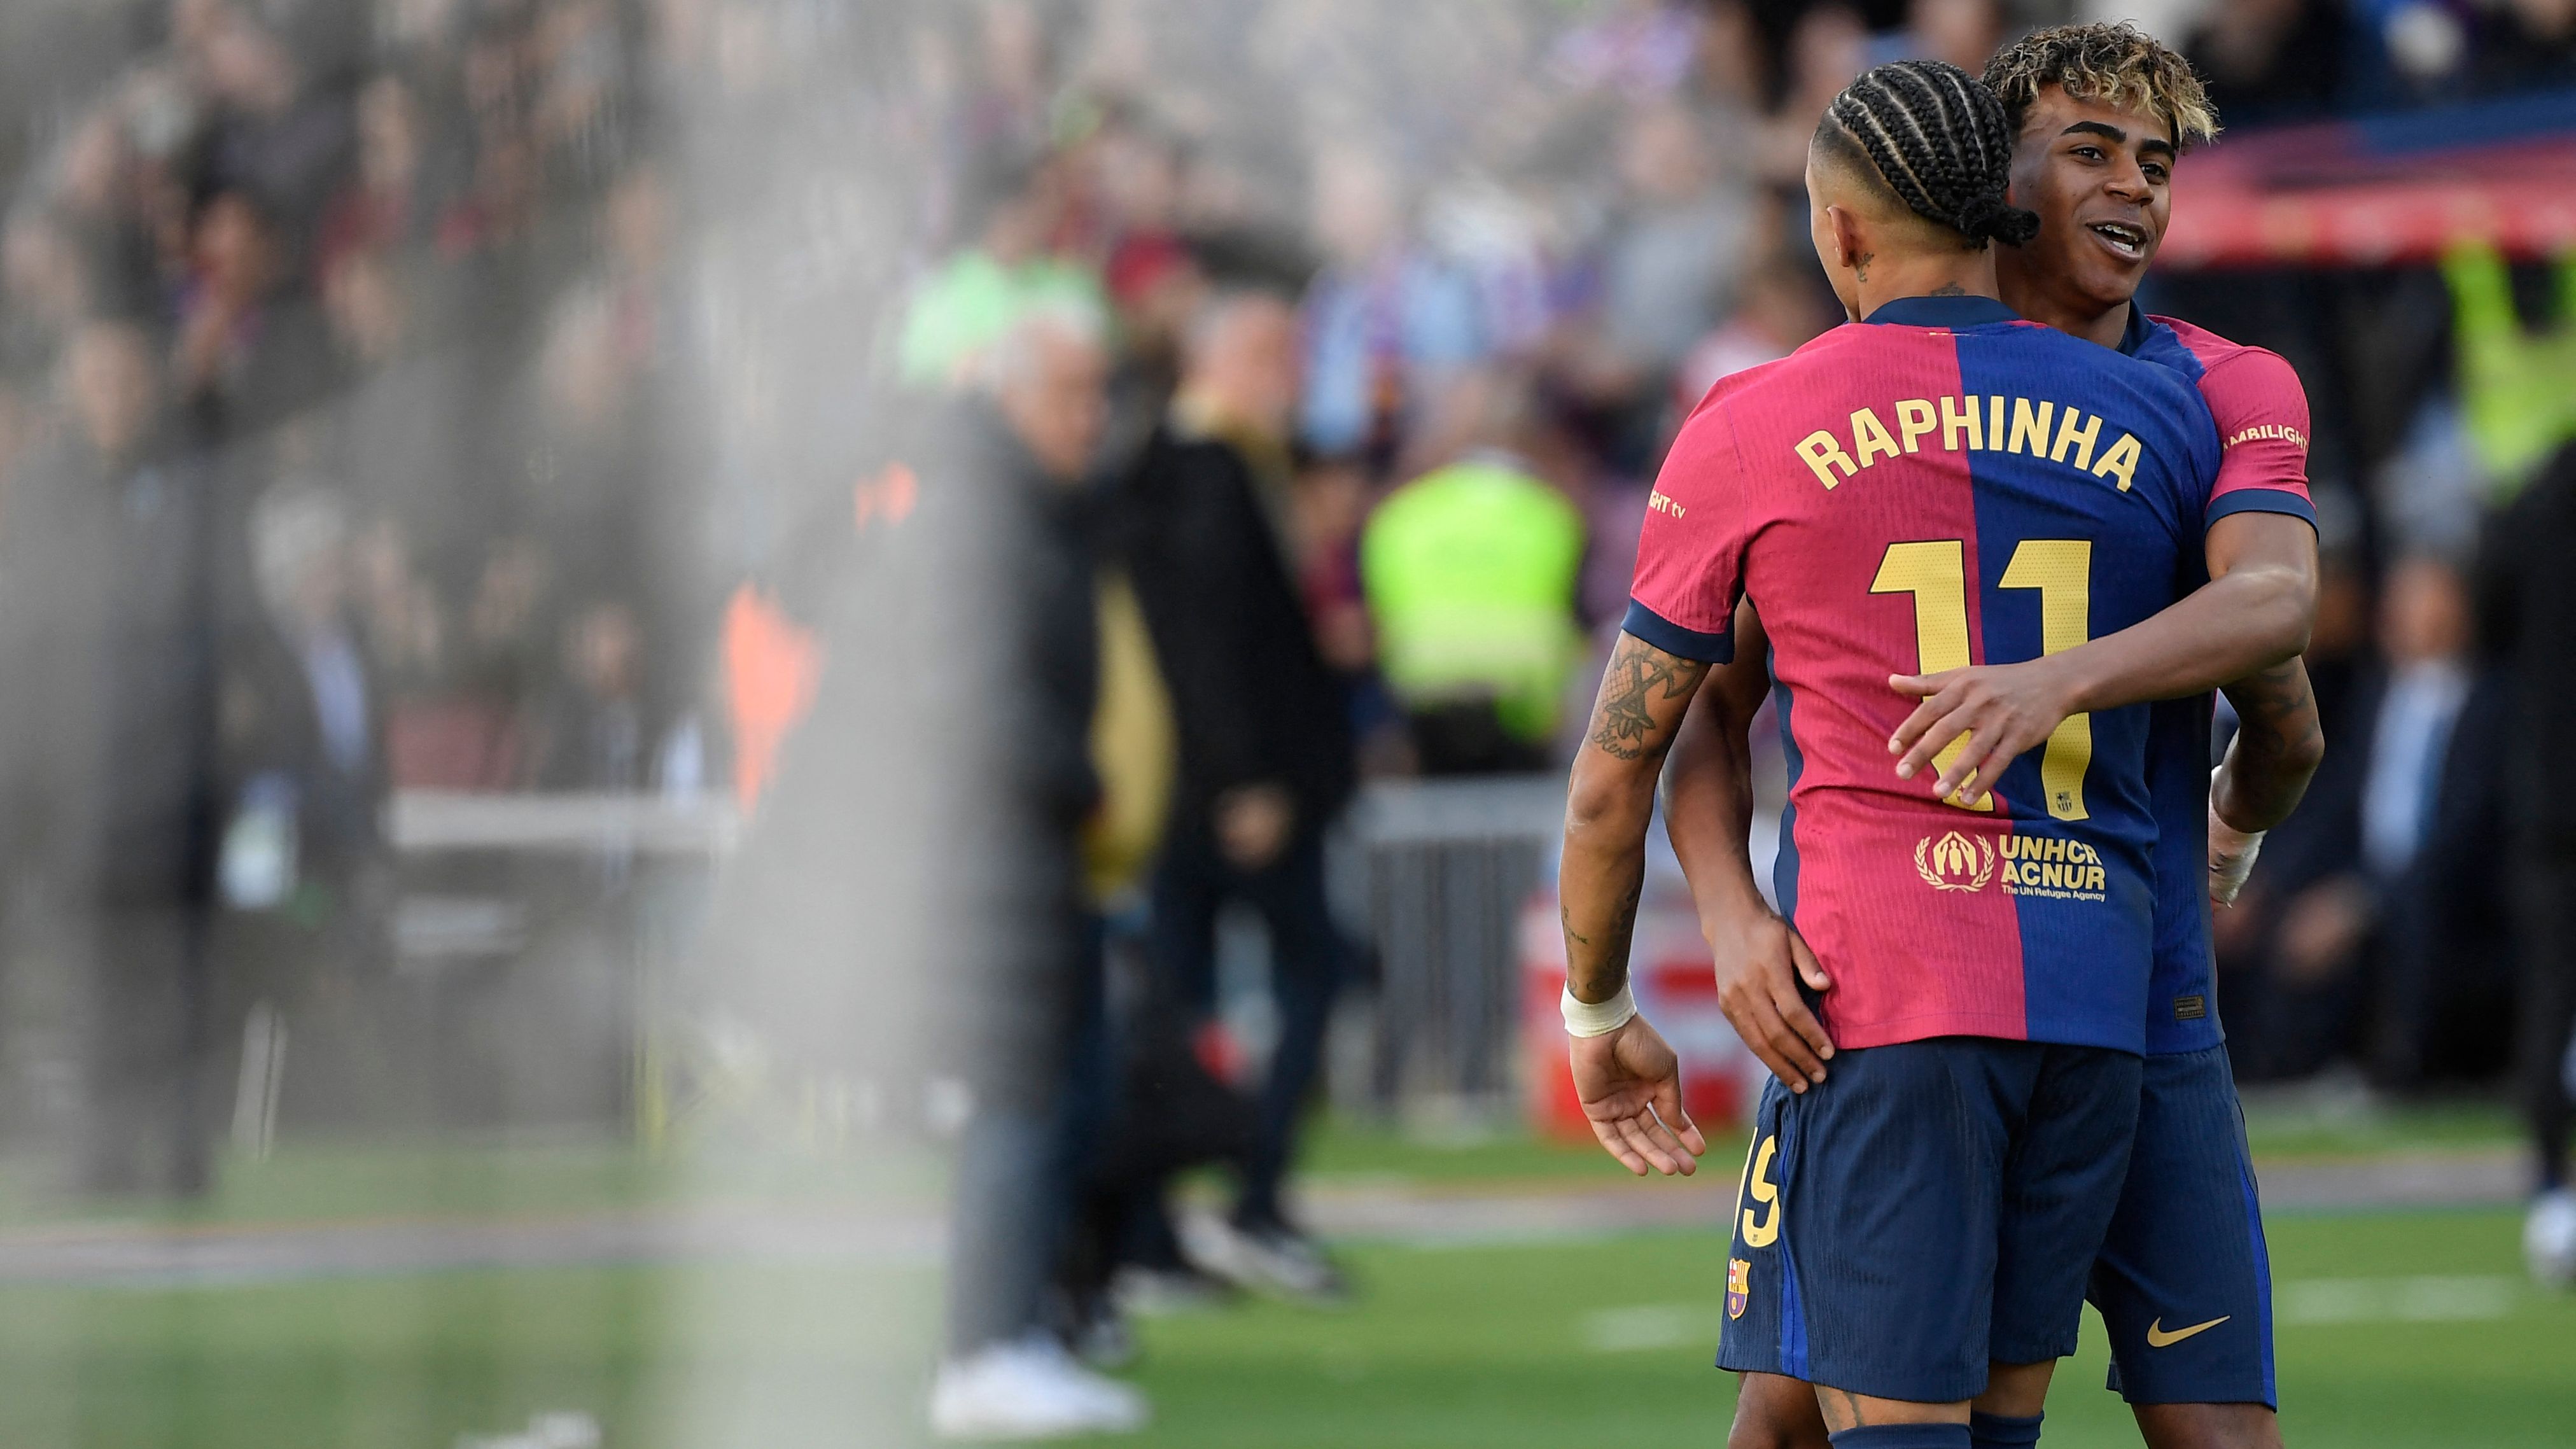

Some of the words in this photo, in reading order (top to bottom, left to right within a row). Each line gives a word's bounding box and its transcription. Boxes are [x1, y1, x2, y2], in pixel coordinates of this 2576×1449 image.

[1795, 395, 2142, 493] RAPHINHA
[1672, 501, 1686, 519] tv
[1869, 539, 2093, 822] 11
[1999, 834, 2103, 865] UNHCR
[2001, 861, 2105, 890] ACNUR
[2002, 885, 2019, 894] The
[2020, 886, 2034, 895] UN
[2035, 888, 2071, 899] Refugee
[2073, 891, 2106, 902] Agency
[1733, 1126, 1780, 1248] 9
